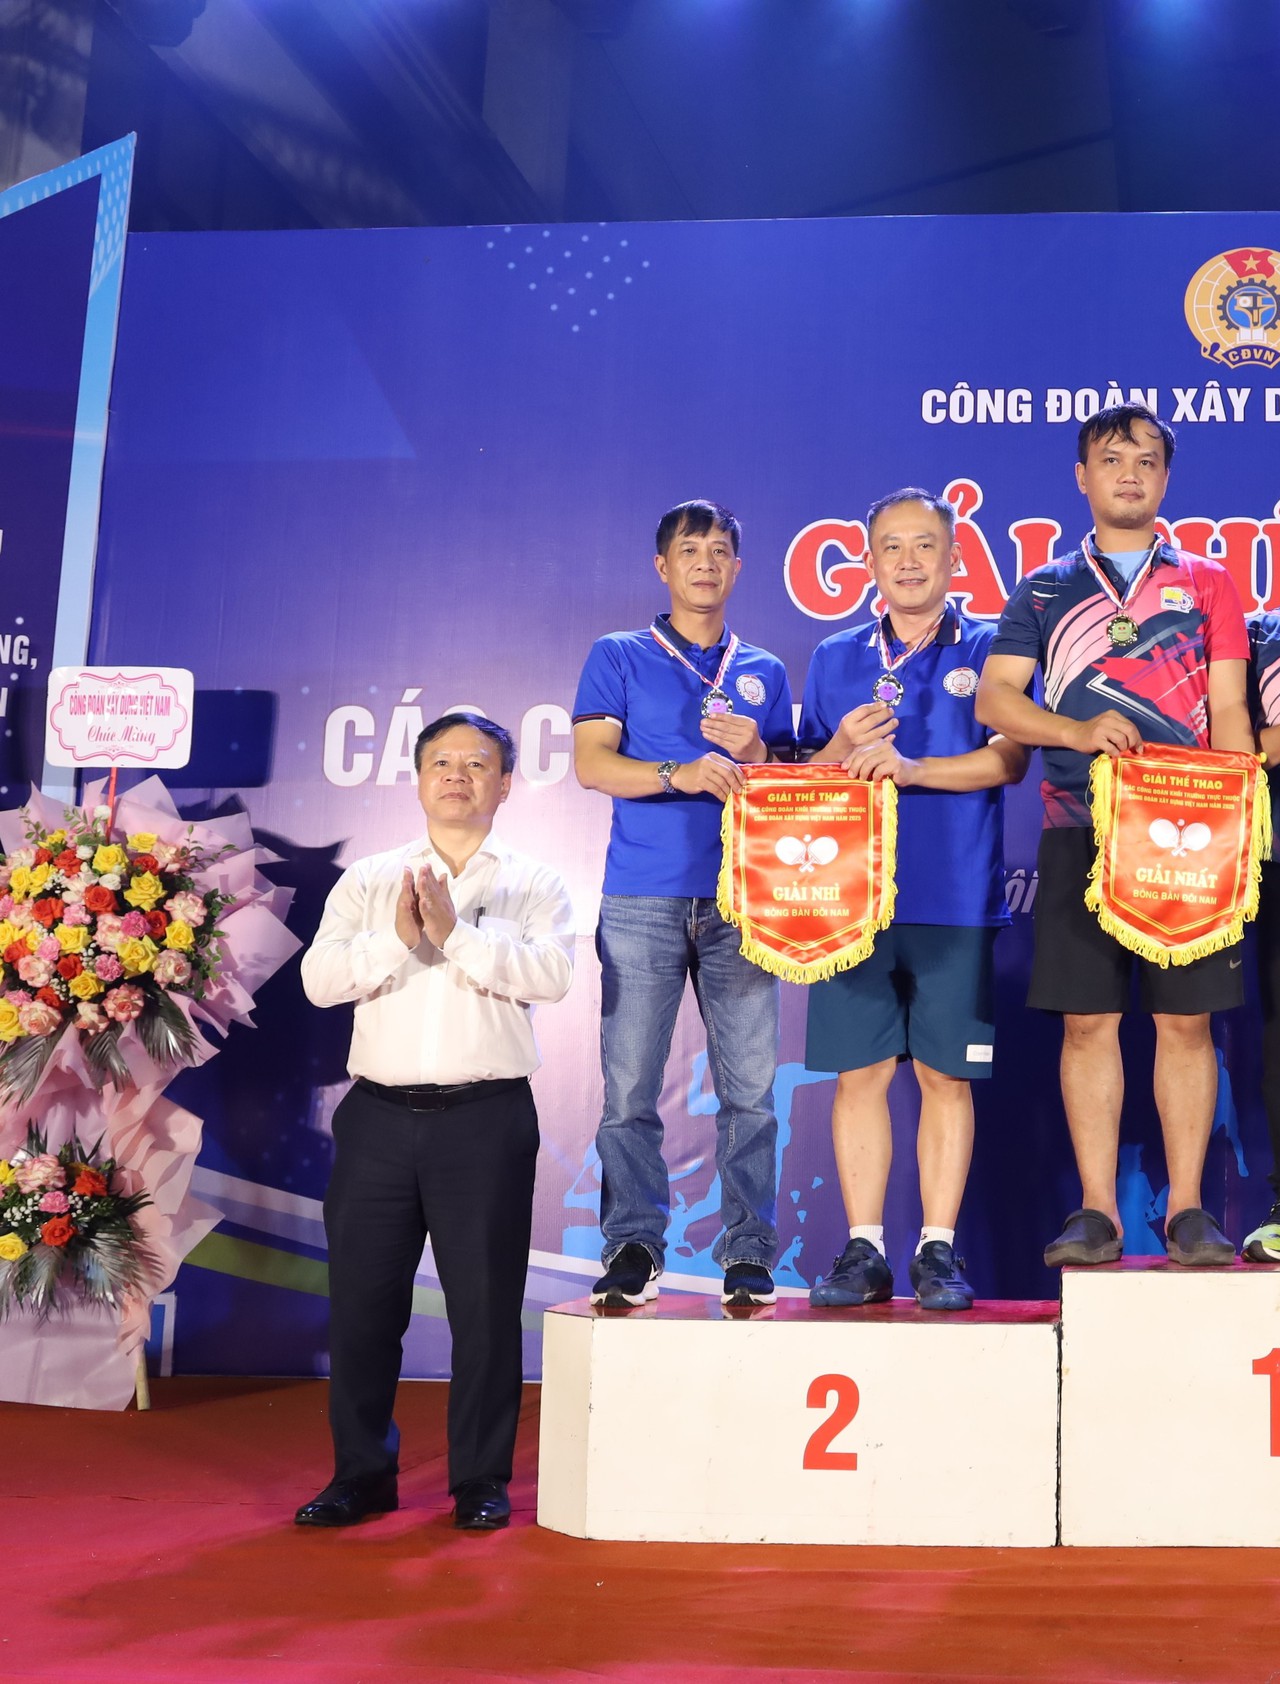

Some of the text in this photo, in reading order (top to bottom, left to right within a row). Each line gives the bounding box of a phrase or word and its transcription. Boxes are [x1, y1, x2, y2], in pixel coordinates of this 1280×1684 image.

[1228, 348, 1275, 362] CĐVN
[921, 381, 1033, 424] CÔNG
[1171, 380, 1252, 422] XÂY
[783, 477, 1062, 621] GẢI
[154, 696, 171, 716] NAM
[323, 688, 488, 787] CÁ
[1143, 773, 1223, 789] GIẢI THỂ THAO
[768, 790, 849, 802] GIẢI THỂ THAO
[1136, 865, 1218, 888] GIẢI NHẤT
[773, 881, 840, 901] GIẢI NHÌ
[1133, 888, 1217, 904] BÓNG BÀN ĐÔI NAM
[764, 908, 788, 917] BÓNG
[792, 907, 810, 916] BÀN
[813, 907, 828, 916] ĐÔI
[802, 1374, 860, 1471] 2
